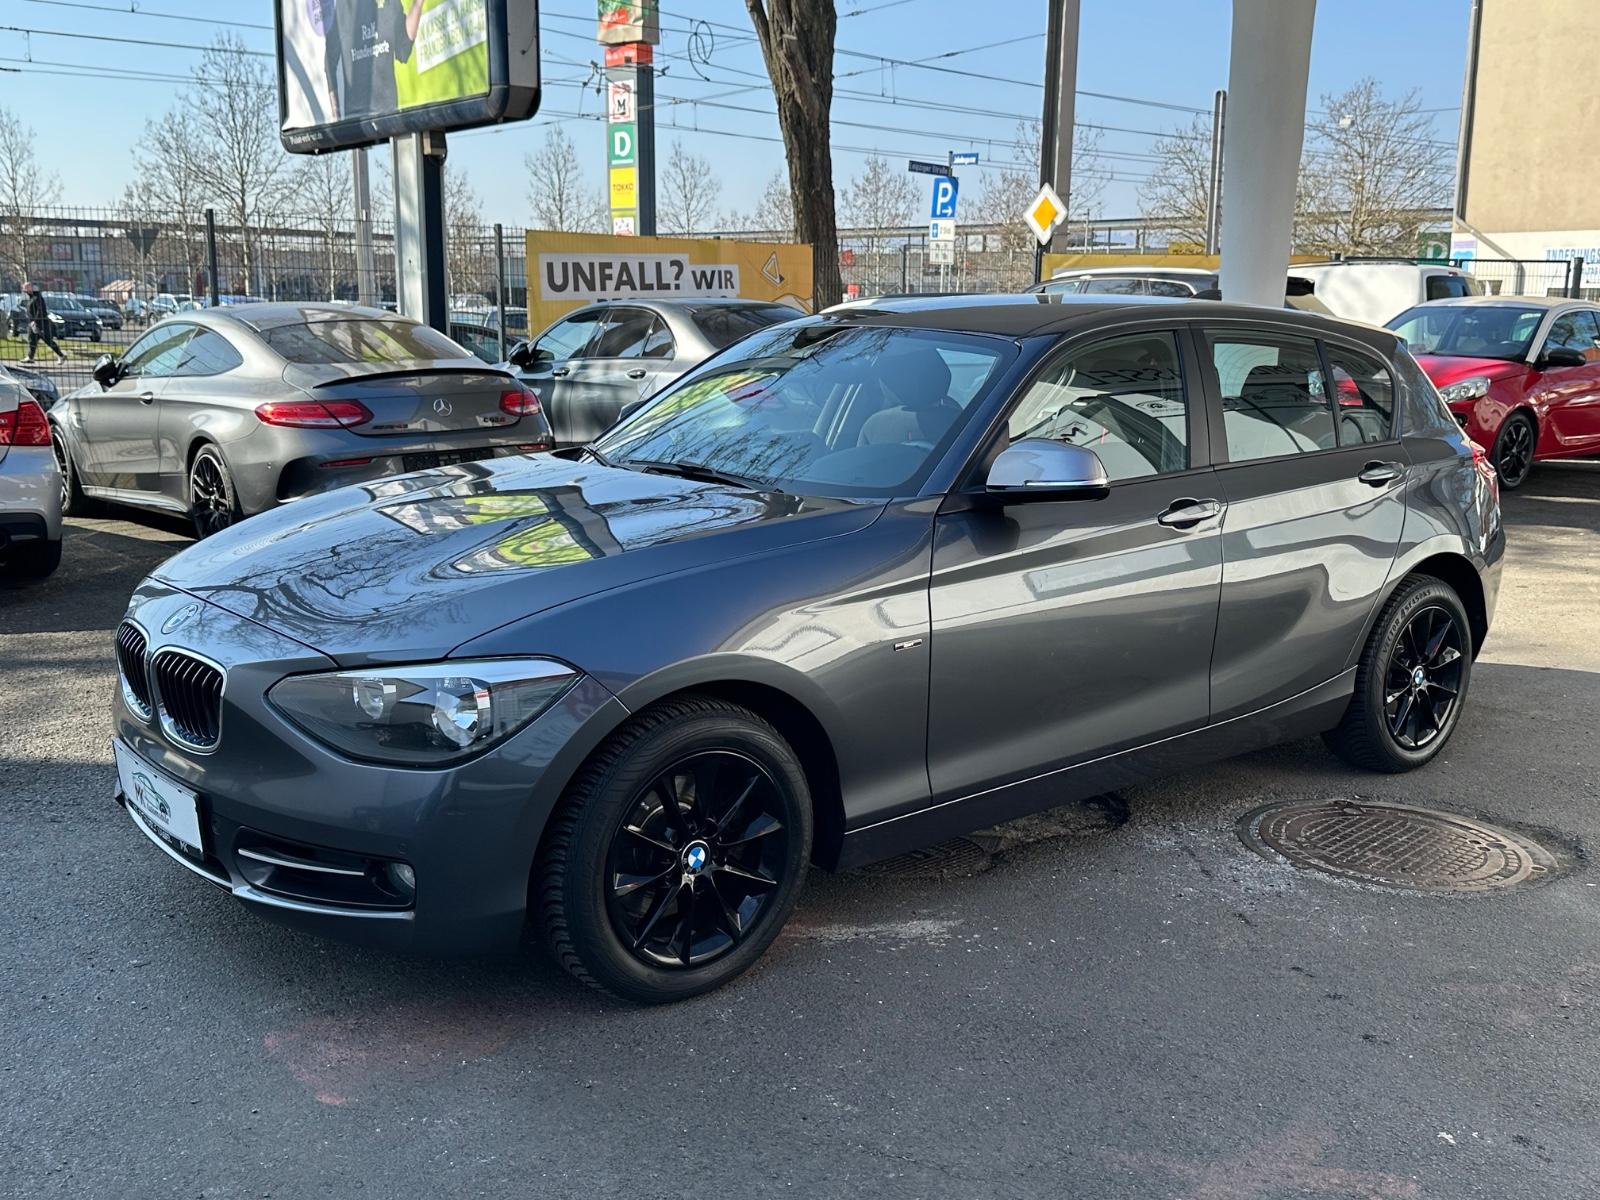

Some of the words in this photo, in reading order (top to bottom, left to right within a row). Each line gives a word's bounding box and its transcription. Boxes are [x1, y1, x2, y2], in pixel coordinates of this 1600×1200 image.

[614, 131, 631, 157] D
[612, 184, 634, 192] TOKKO
[936, 182, 953, 216] P
[546, 259, 684, 293] UNFALL?
[692, 269, 735, 289] WIR
